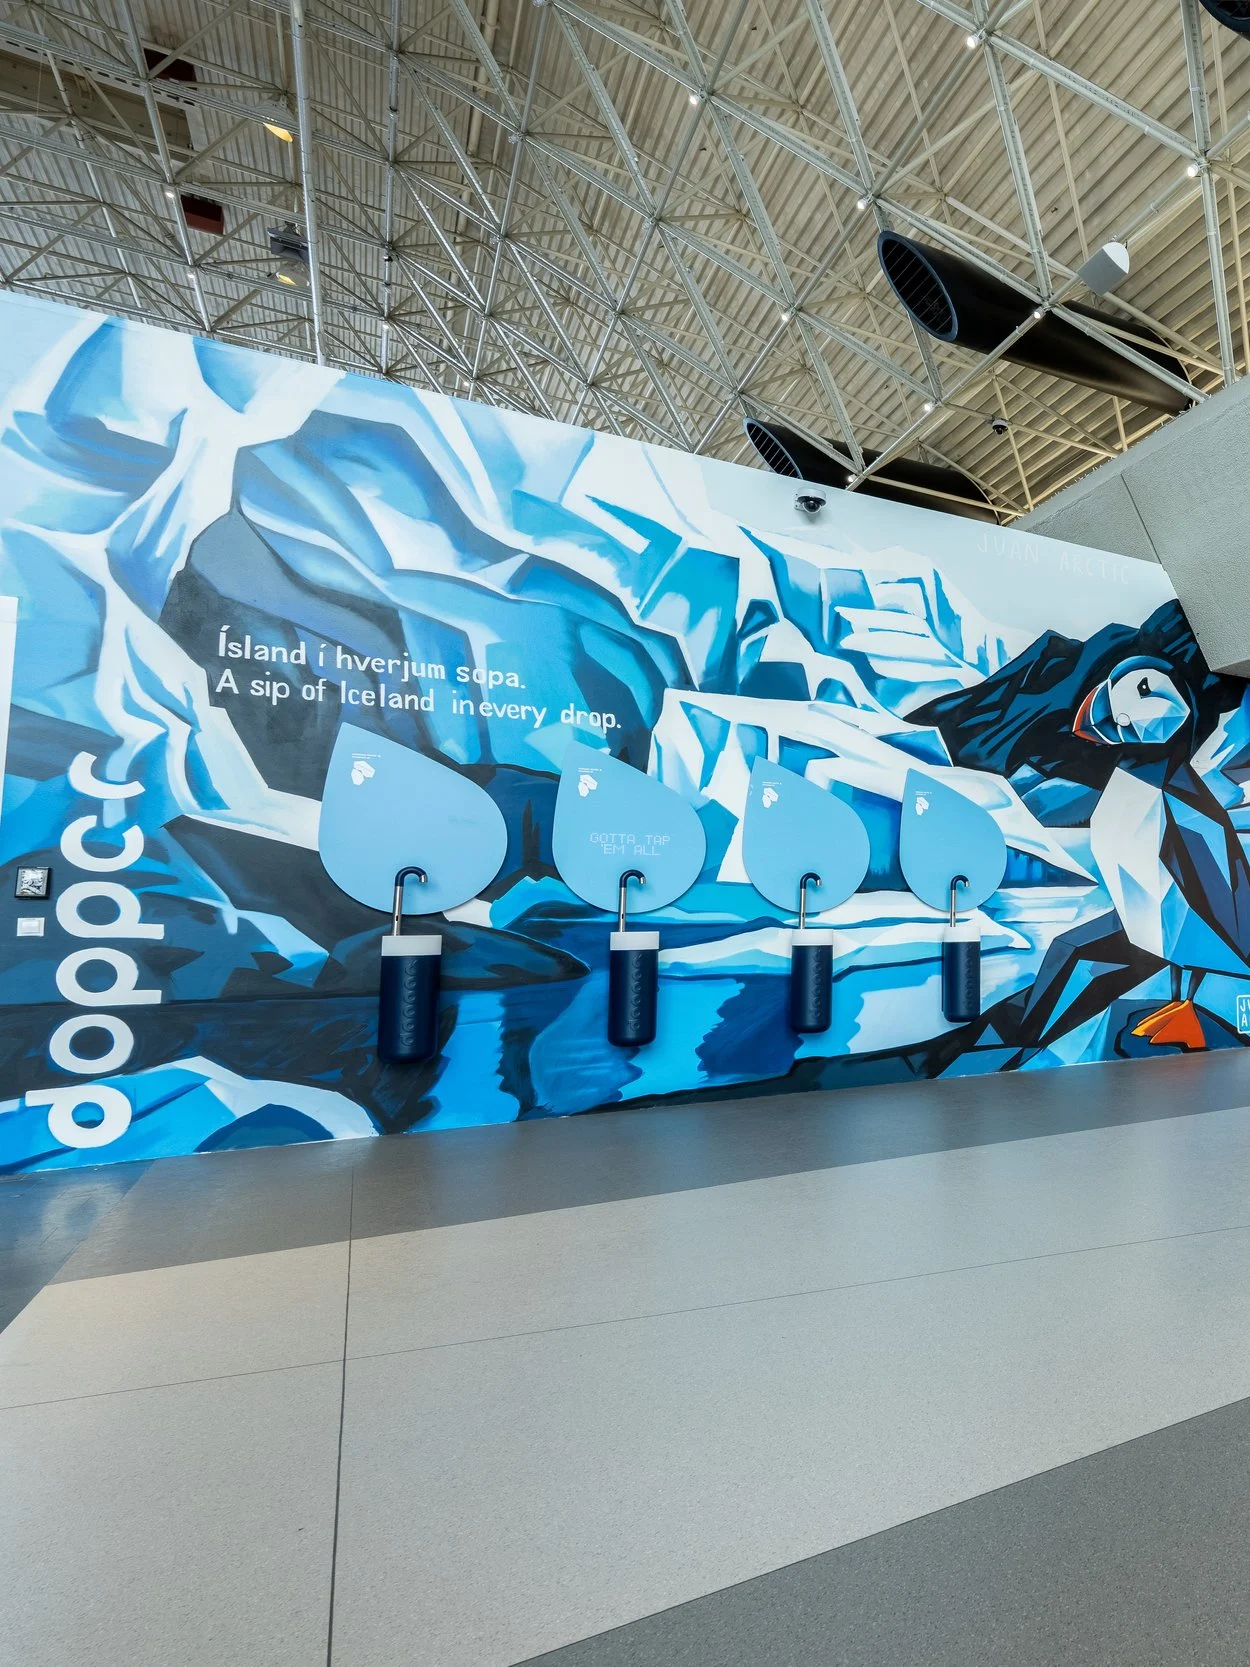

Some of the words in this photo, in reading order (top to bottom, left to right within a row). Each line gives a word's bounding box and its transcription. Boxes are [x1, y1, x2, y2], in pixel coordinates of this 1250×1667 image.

[976, 532, 1040, 564] JUAN
[1059, 551, 1130, 585] ARCTIC
[218, 625, 306, 666] Ísland
[318, 643, 327, 668] í
[336, 645, 446, 684] hverjum
[456, 666, 527, 690] sopa.
[216, 669, 239, 695] A
[250, 671, 290, 706] sip
[302, 677, 329, 702] of
[341, 680, 435, 713] Iceland
[452, 691, 475, 716] in
[479, 698, 547, 729] every
[561, 702, 622, 735] drop.
[590, 832, 636, 845] GOTTA
[645, 834, 671, 846] TAP
[634, 845, 661, 856] ALL
